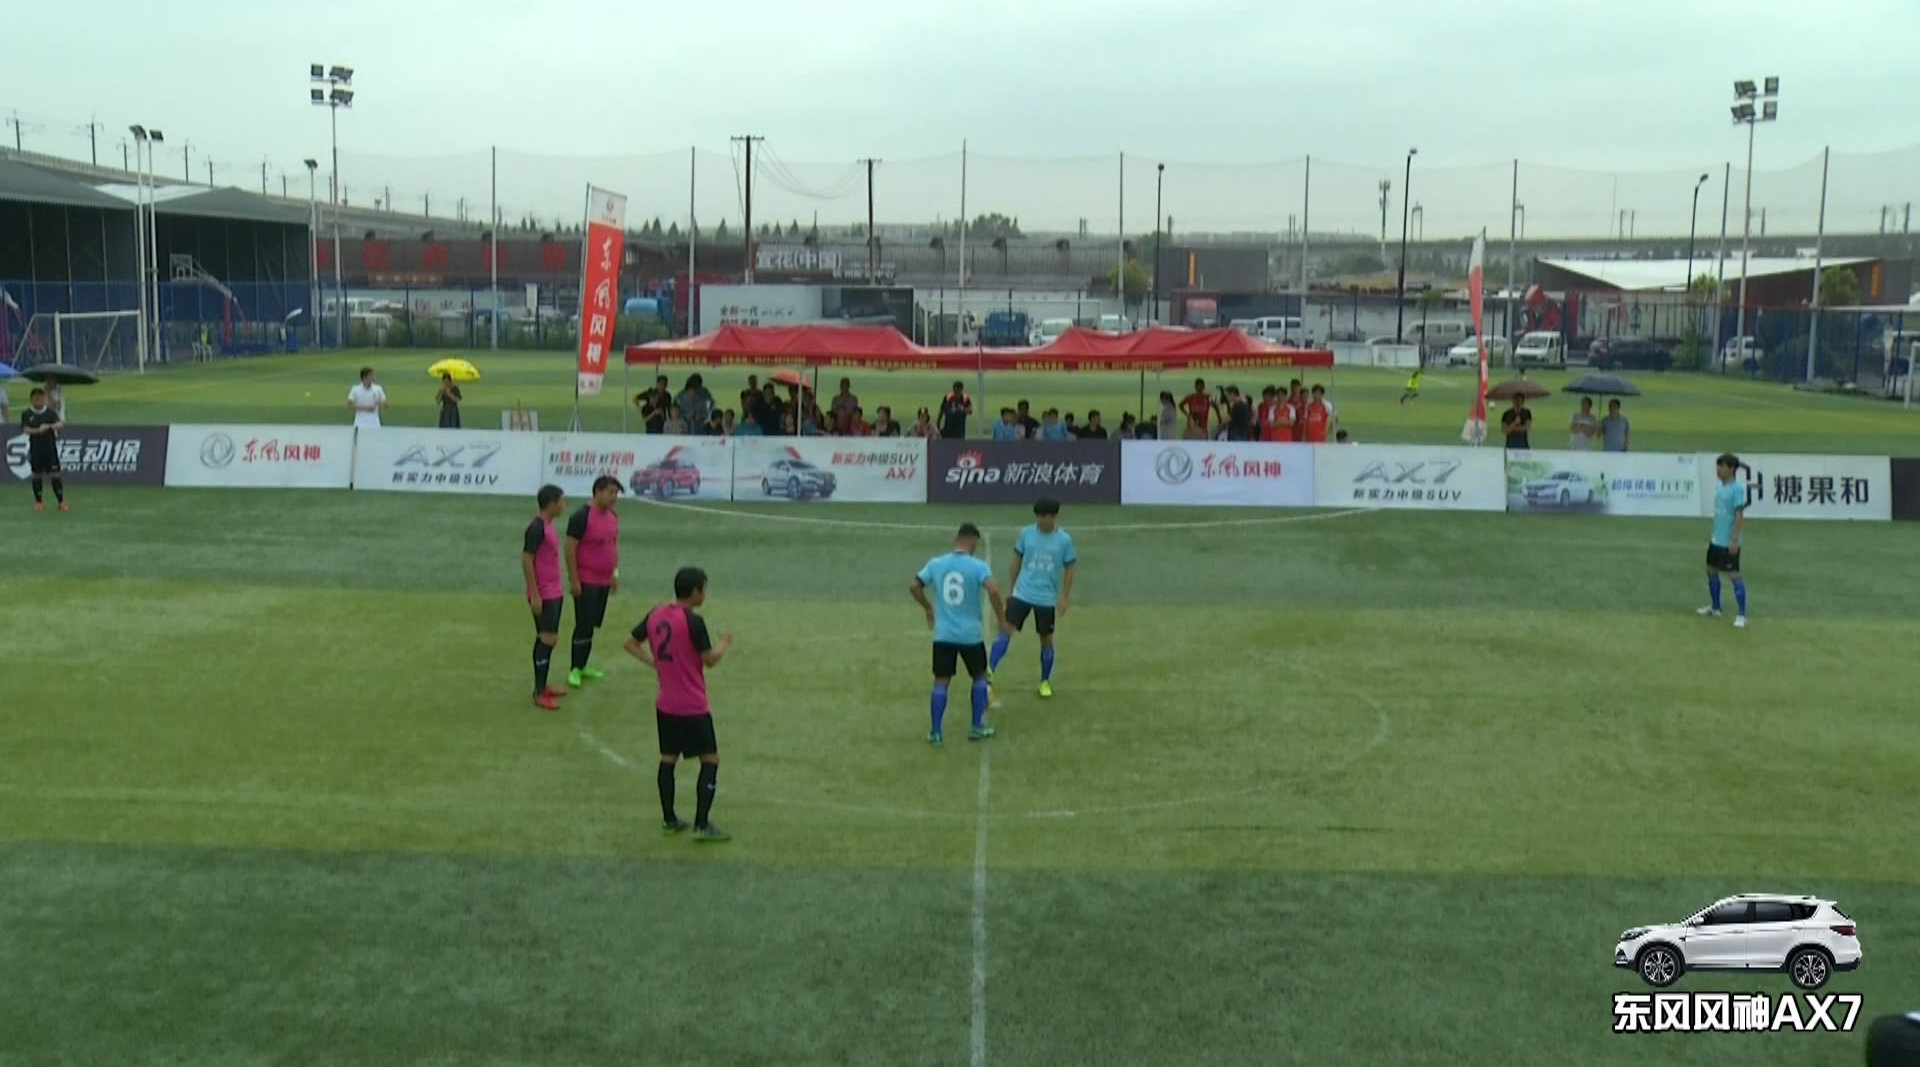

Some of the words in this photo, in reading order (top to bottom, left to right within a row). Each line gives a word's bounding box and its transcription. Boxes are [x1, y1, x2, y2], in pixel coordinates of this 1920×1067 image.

[394, 442, 502, 469] AX7
[1352, 457, 1462, 484] AX7
[945, 457, 1000, 490] sina
[1003, 461, 1105, 486] 新浪体育
[1773, 474, 1870, 506] 糖果和
[943, 571, 965, 606] 6
[656, 621, 673, 662] 2
